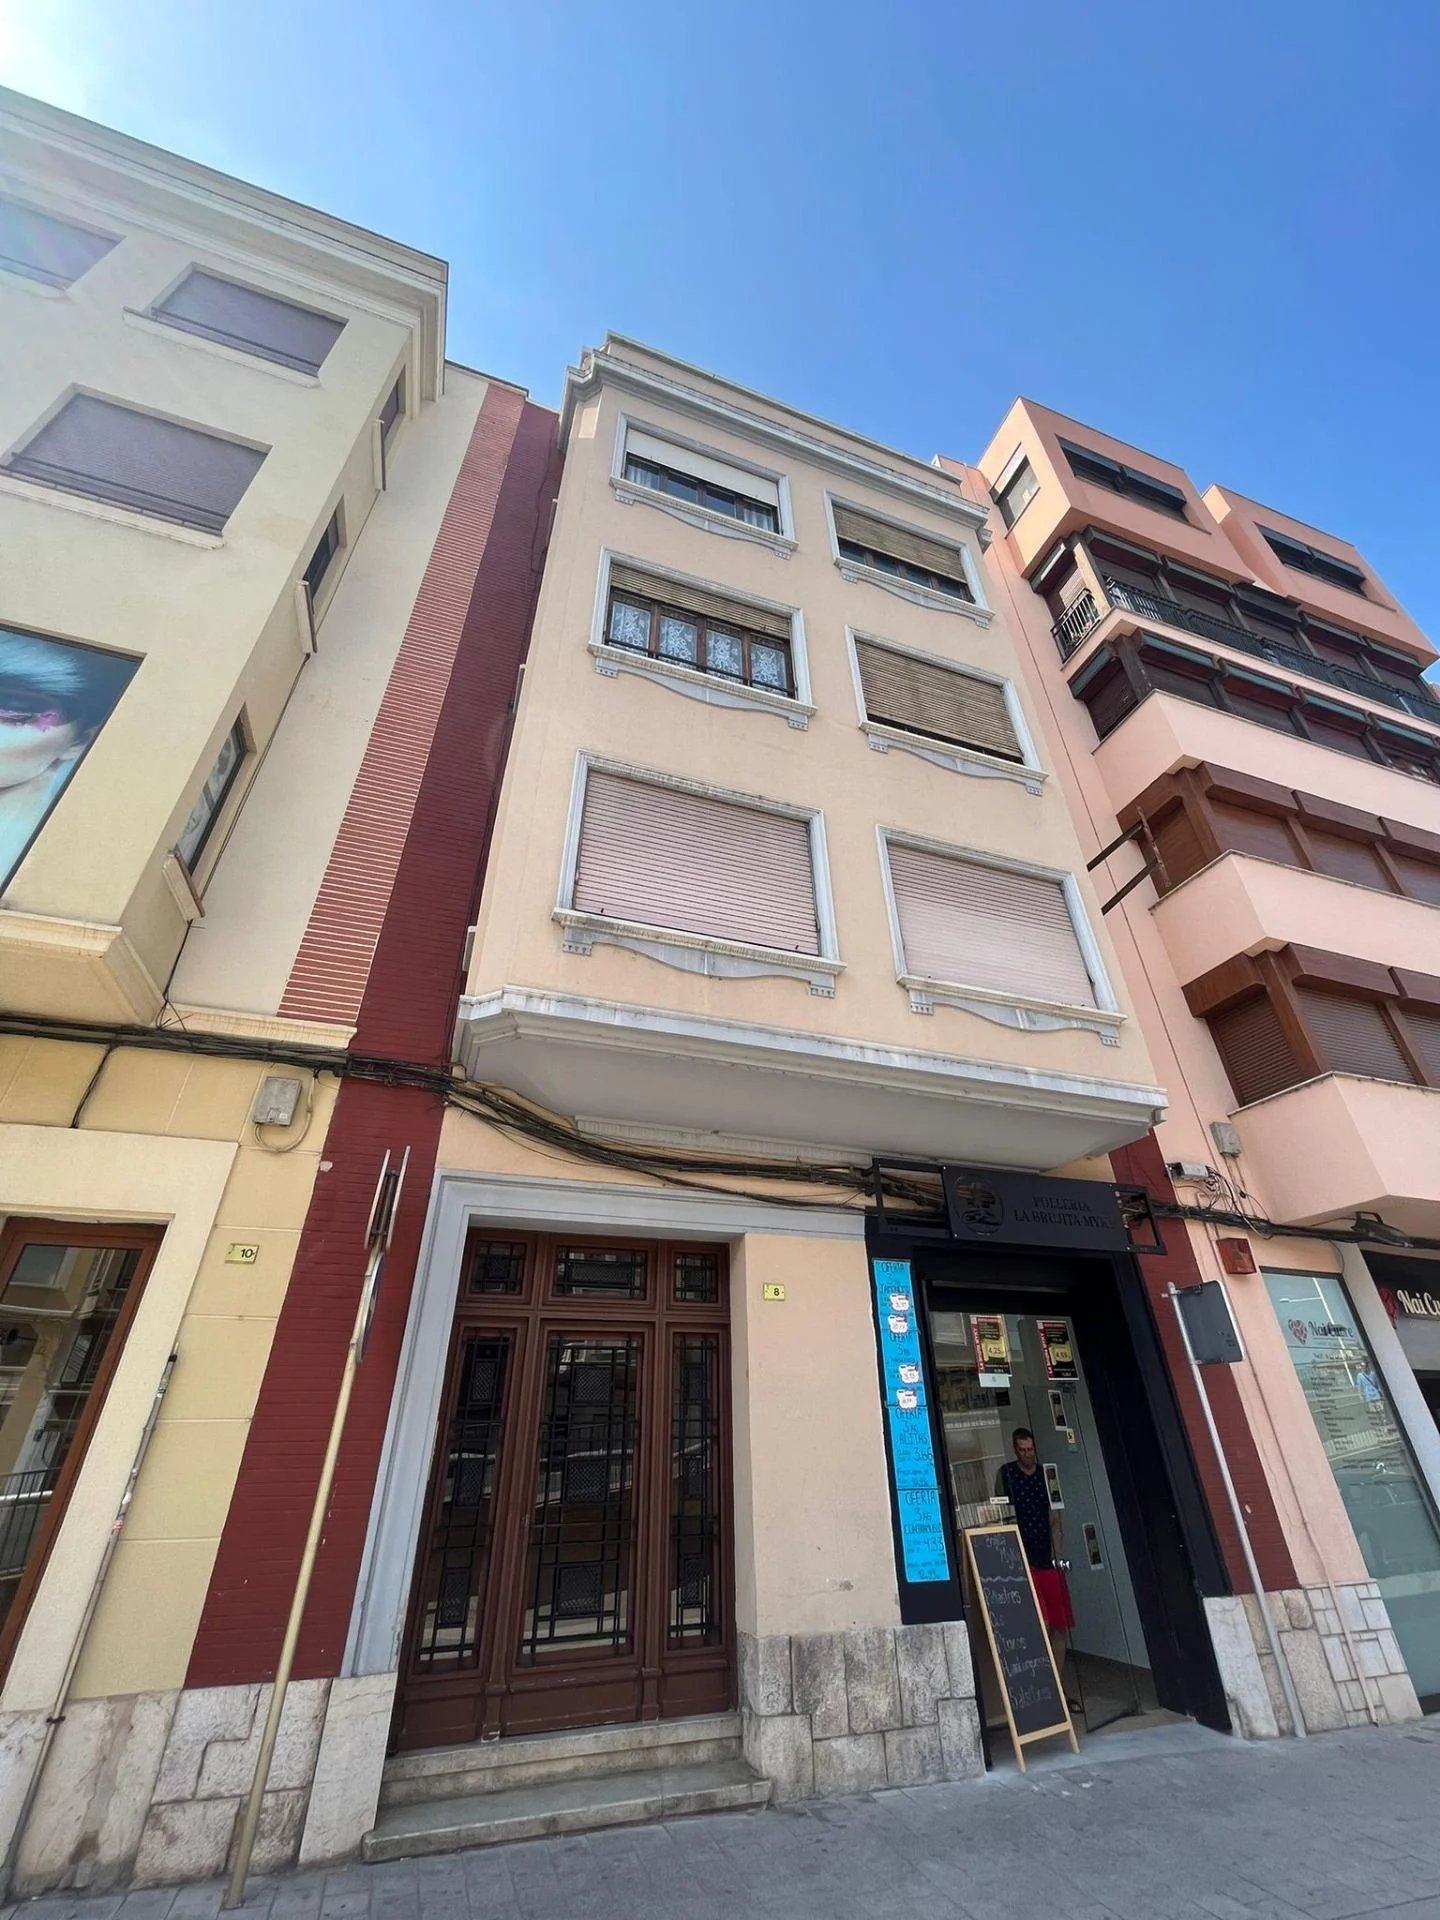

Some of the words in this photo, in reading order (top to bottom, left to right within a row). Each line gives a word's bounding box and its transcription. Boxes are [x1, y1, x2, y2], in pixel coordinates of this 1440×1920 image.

[1014, 1209, 1030, 1222] LA
[1032, 1210, 1081, 1227] BRUJITA
[240, 1248, 254, 1259] 10
[773, 1287, 780, 1297] 8
[1397, 1289, 1427, 1314] Nai
[895, 1408, 923, 1420] OFERTA
[899, 1432, 928, 1446] ALITAS
[904, 1490, 936, 1505] OFERTA
[914, 1507, 922, 1522] 3
